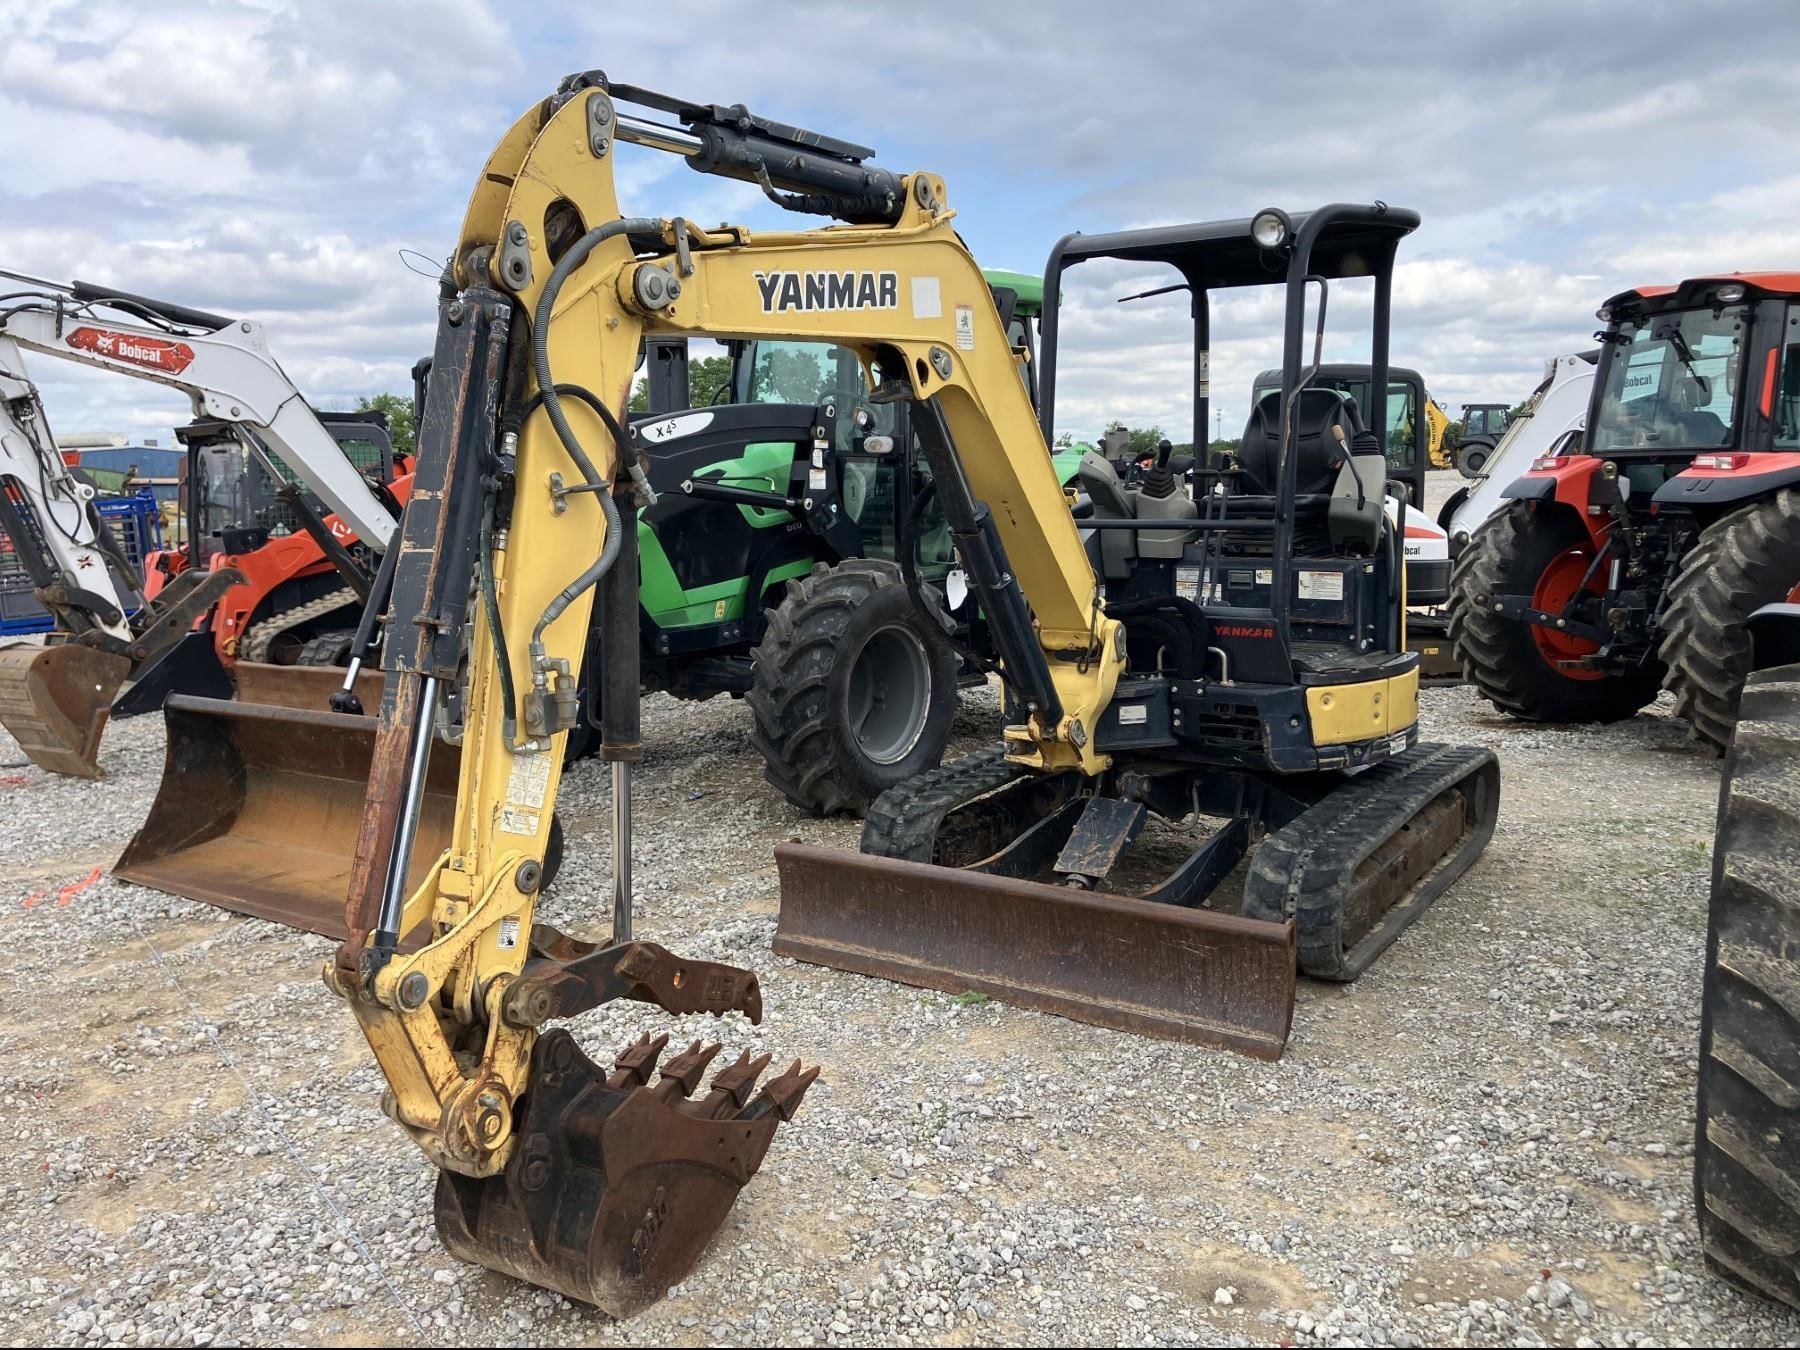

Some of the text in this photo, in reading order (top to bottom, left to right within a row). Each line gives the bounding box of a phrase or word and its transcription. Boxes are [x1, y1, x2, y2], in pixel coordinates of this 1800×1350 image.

[754, 272, 898, 312] YANMAR
[118, 342, 162, 363] Bobcat
[1404, 546, 1421, 555] bcat
[1214, 625, 1274, 639] YANMAR
